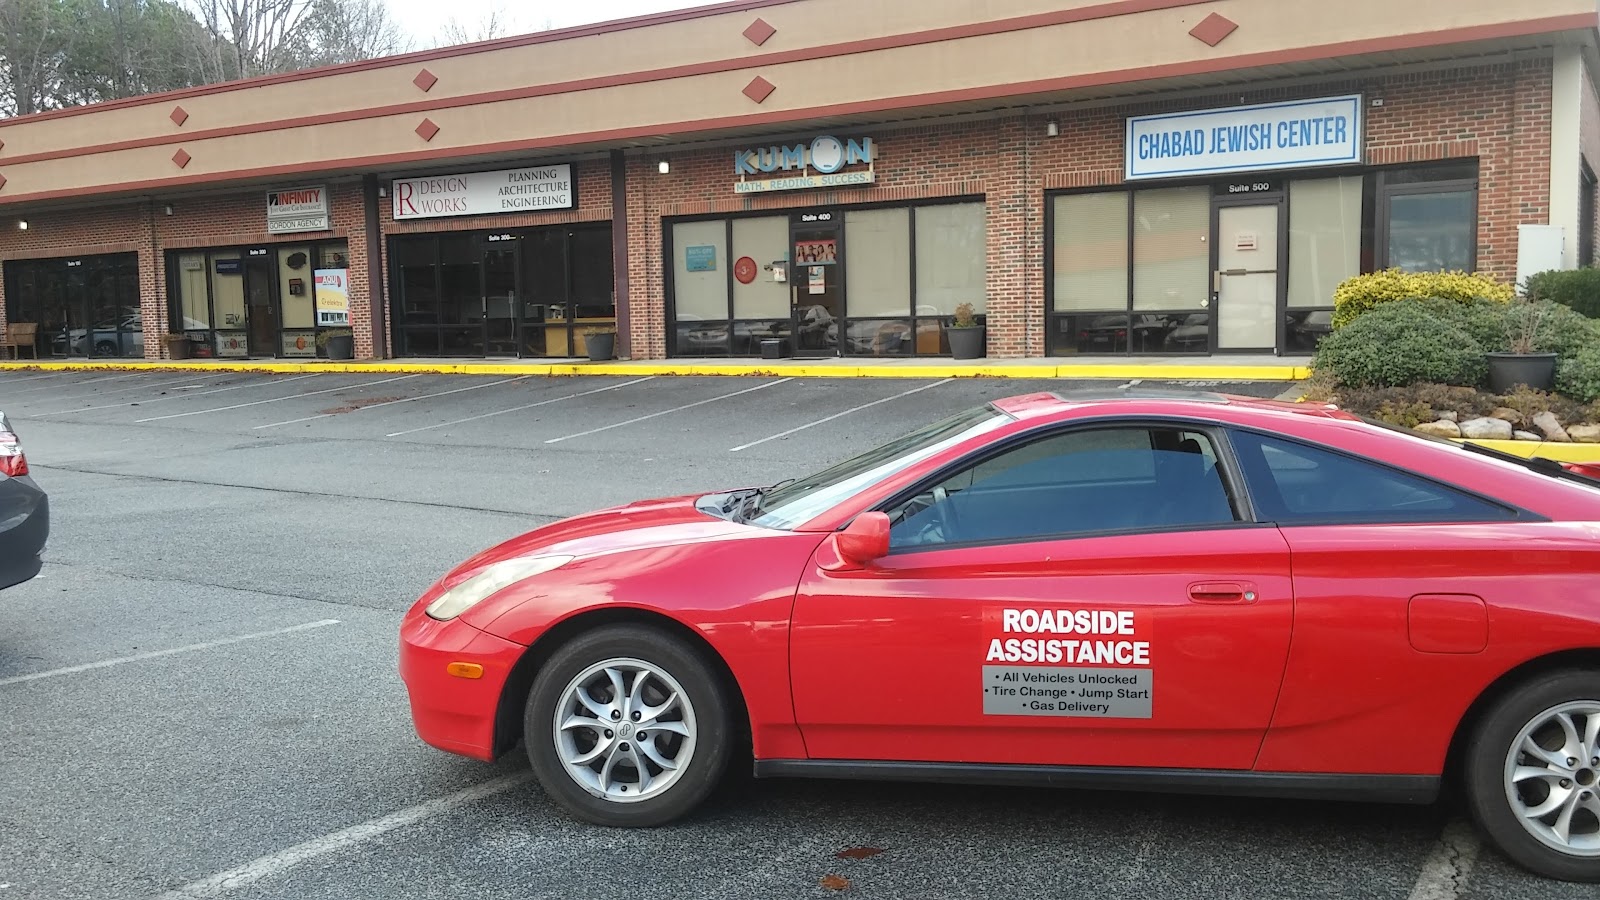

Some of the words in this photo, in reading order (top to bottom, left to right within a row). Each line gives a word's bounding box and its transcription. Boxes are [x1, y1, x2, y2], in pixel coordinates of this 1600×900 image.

[1139, 129, 1204, 160] CHABAD
[1209, 123, 1271, 154] JEWISH
[1277, 116, 1347, 149] CENTER
[734, 135, 873, 175] KUMON
[508, 169, 557, 182] PLANNING
[736, 182, 765, 192] MATH.
[770, 178, 817, 190] READING.
[821, 173, 869, 186] SUCCESS.
[420, 177, 467, 194] DESIGN
[498, 181, 568, 196] ARCHITECTURE
[1228, 184, 1250, 193] Suite
[1252, 182, 1270, 191] 500
[278, 189, 320, 206] INFINITY
[398, 182, 419, 216] R
[421, 196, 467, 213] WORKS
[501, 195, 566, 209] ENGINEERING
[269, 221, 296, 230] GORDON
[297, 219, 323, 228] AGENCY
[801, 214, 817, 222] Suite
[818, 213, 831, 221] 400
[1003, 608, 1135, 635] ROADSIDE
[985, 638, 1150, 665] ASSISTANCE
[1002, 672, 1019, 682] All
[1022, 672, 1074, 684] Vehicles
[1078, 673, 1137, 685] Unlocked
[992, 686, 1016, 696] Tire
[1019, 686, 1067, 700] Change
[1078, 688, 1113, 700] Jump
[1117, 688, 1149, 699] Start
[1030, 700, 1055, 711] Gas
[1058, 701, 1110, 714] Delivery
